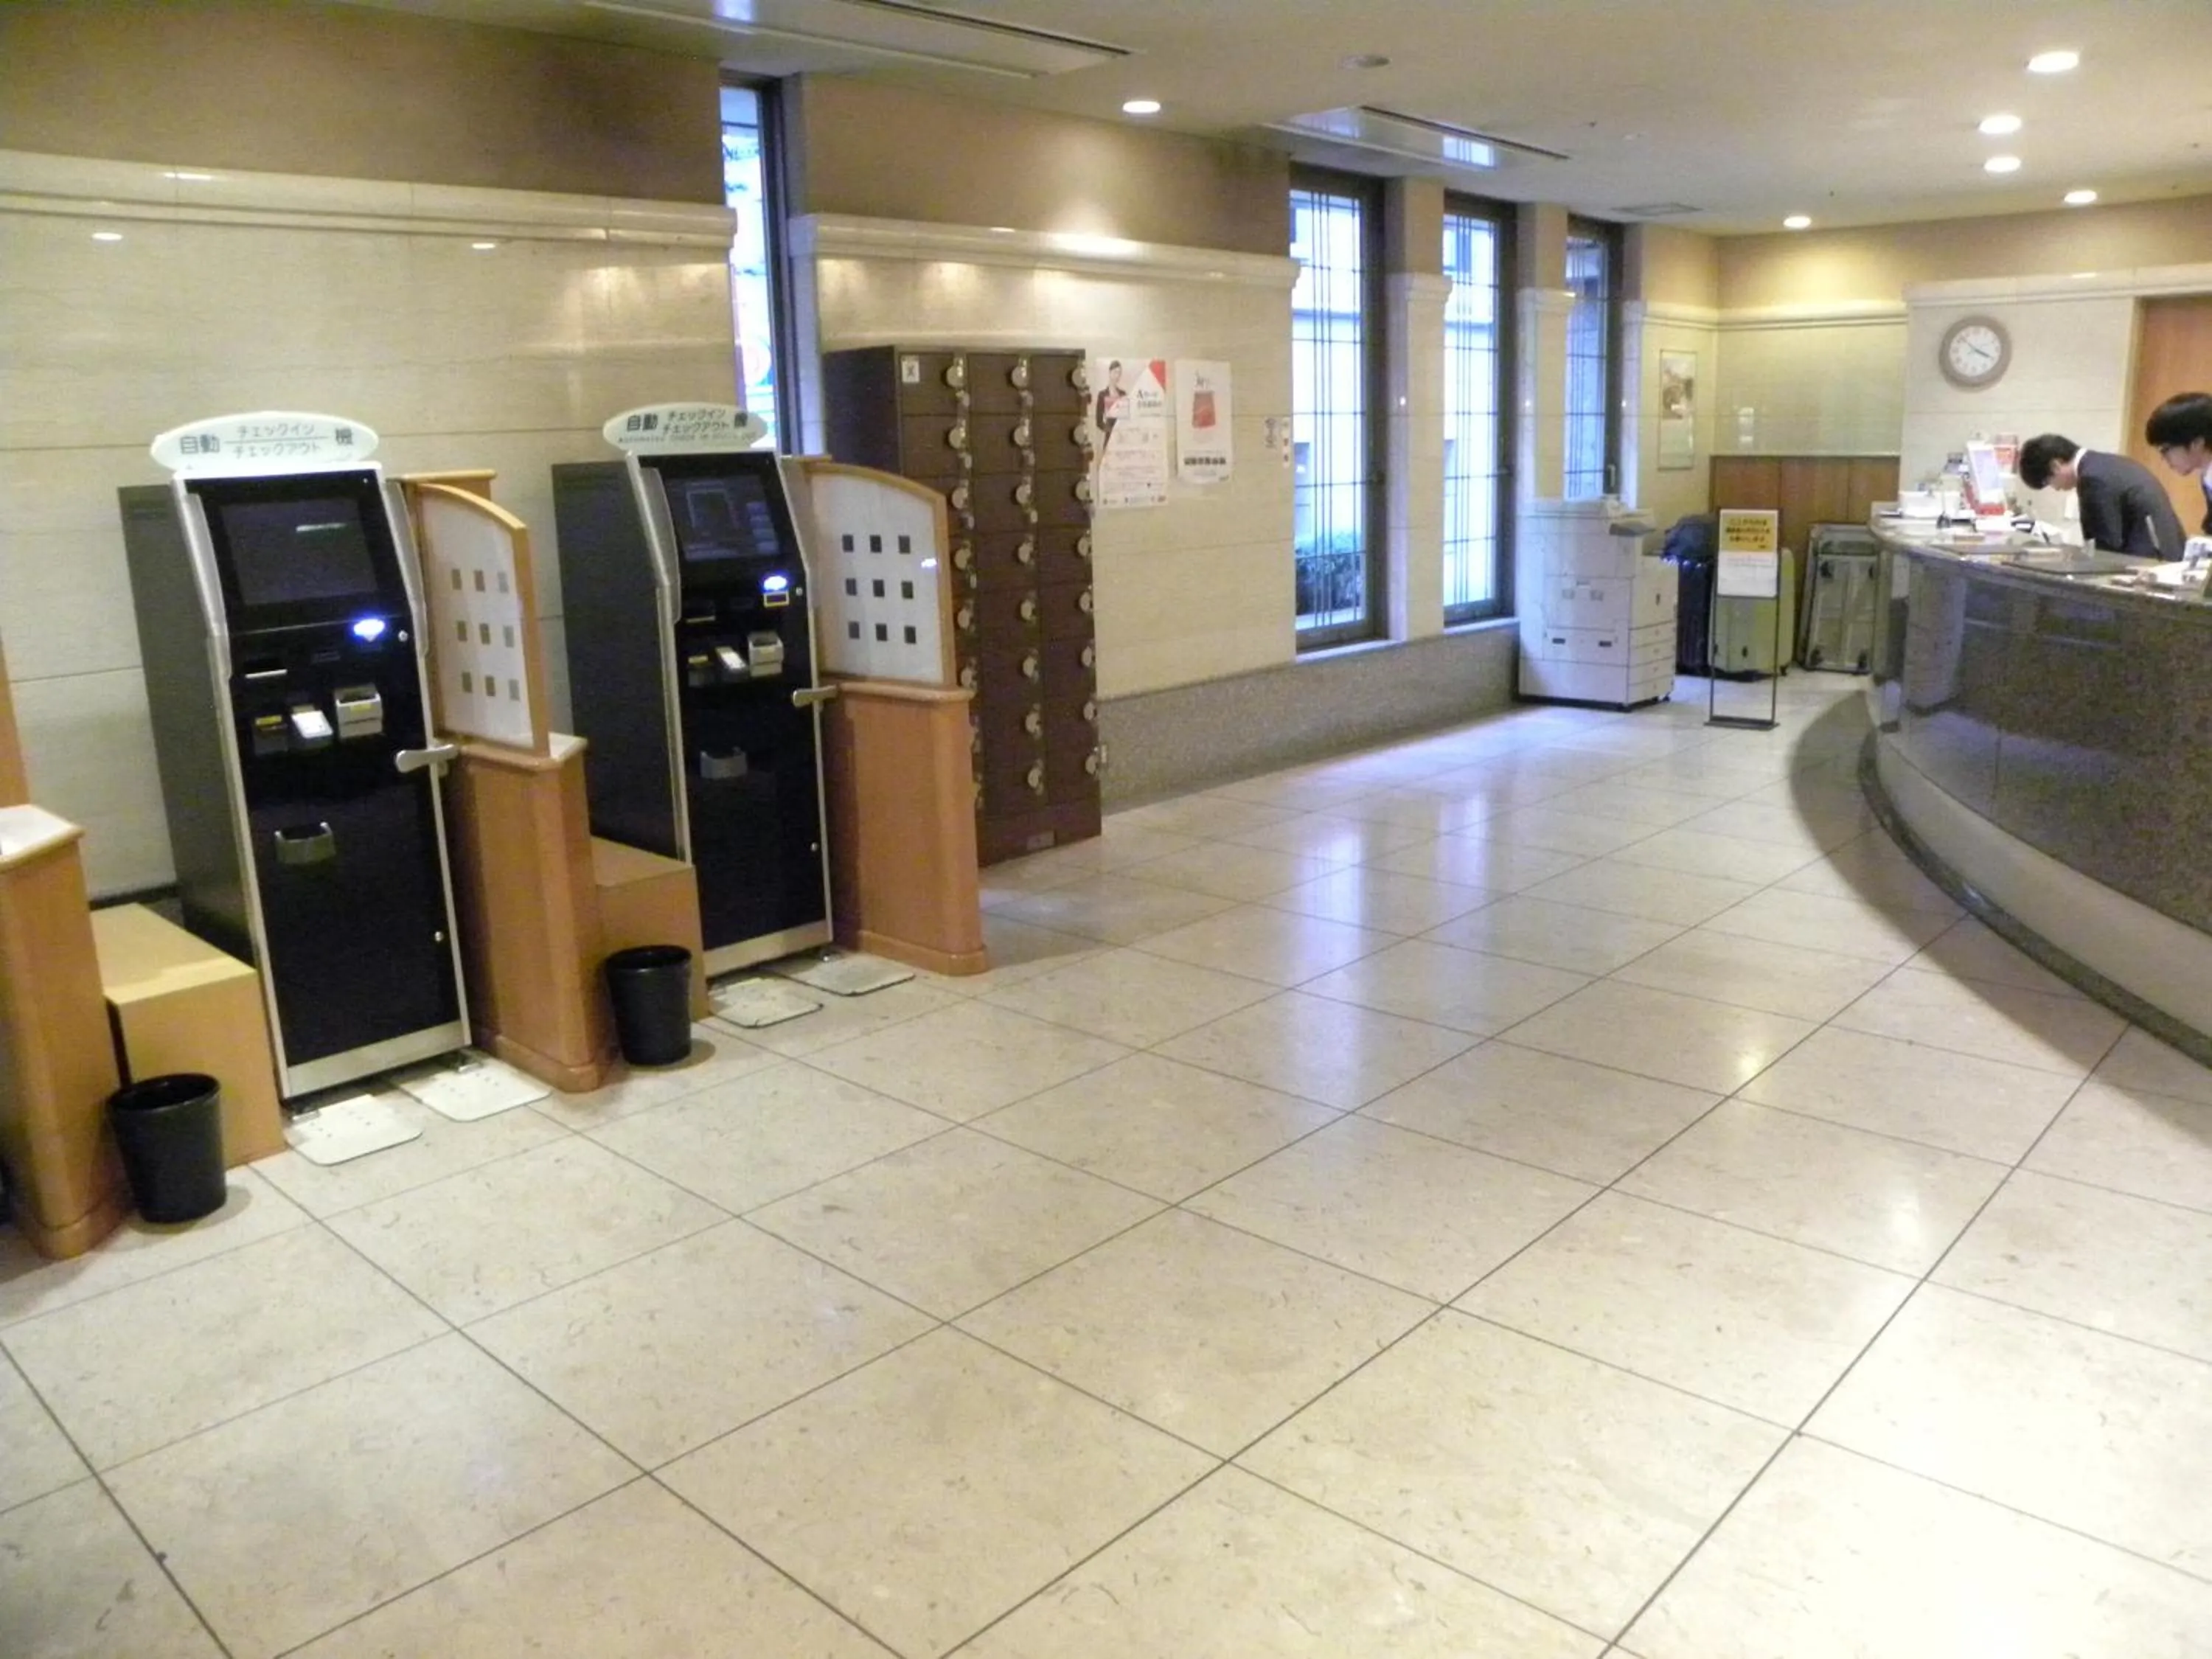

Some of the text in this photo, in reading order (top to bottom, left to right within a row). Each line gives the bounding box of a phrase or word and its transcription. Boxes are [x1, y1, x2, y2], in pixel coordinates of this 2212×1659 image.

[236, 422, 315, 438] チェックイン
[627, 413, 658, 431] 自動
[180, 434, 220, 454] 自動
